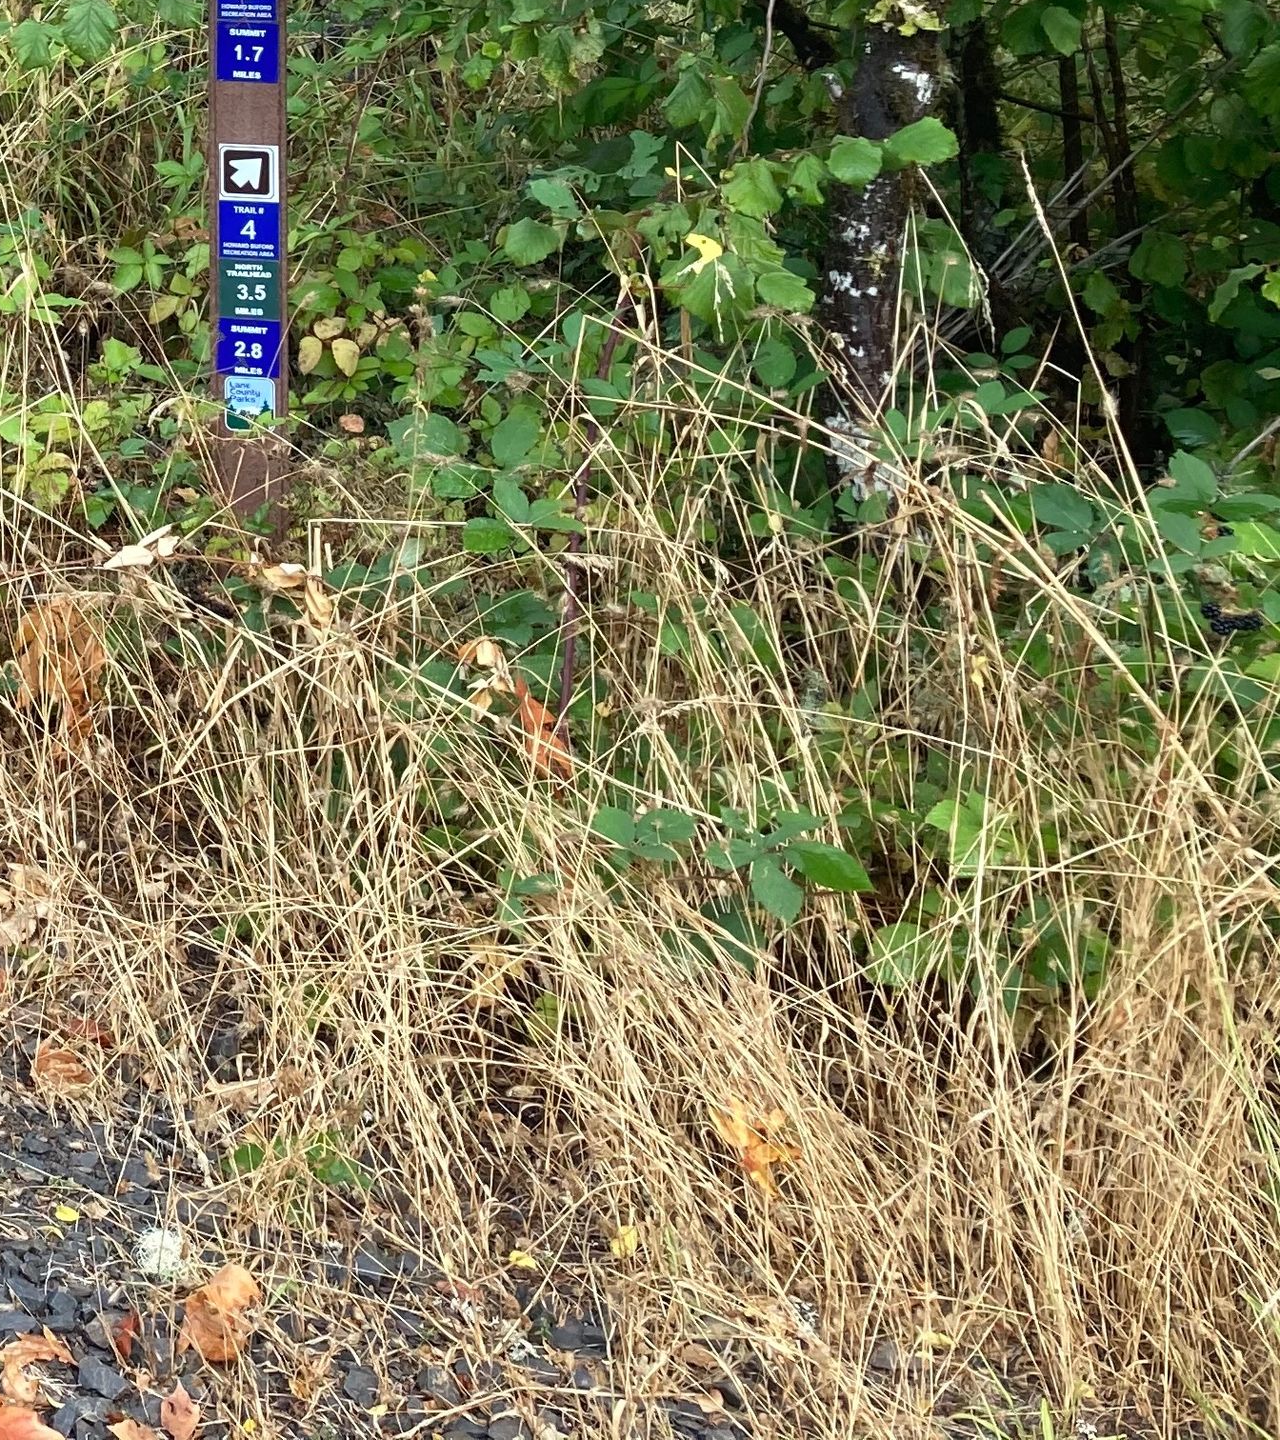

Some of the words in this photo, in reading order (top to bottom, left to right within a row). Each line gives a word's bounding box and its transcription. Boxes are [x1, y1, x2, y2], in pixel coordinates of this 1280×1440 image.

[229, 28, 266, 38] SUMMIT
[234, 44, 264, 62] 1.7
[233, 70, 261, 80] MILES
[234, 206, 256, 214] TRAIL
[240, 220, 257, 240] 4
[234, 263, 263, 271] NORTH
[226, 270, 272, 279] TRAILHEAD
[236, 284, 266, 301] 3.5
[234, 307, 264, 316] MILES
[230, 325, 268, 335] SUMMIT
[234, 341, 263, 360] 2.8
[234, 366, 263, 375] MILES
[229, 381, 250, 390] Lane
[229, 388, 261, 398] County
[229, 395, 256, 404] Parks
